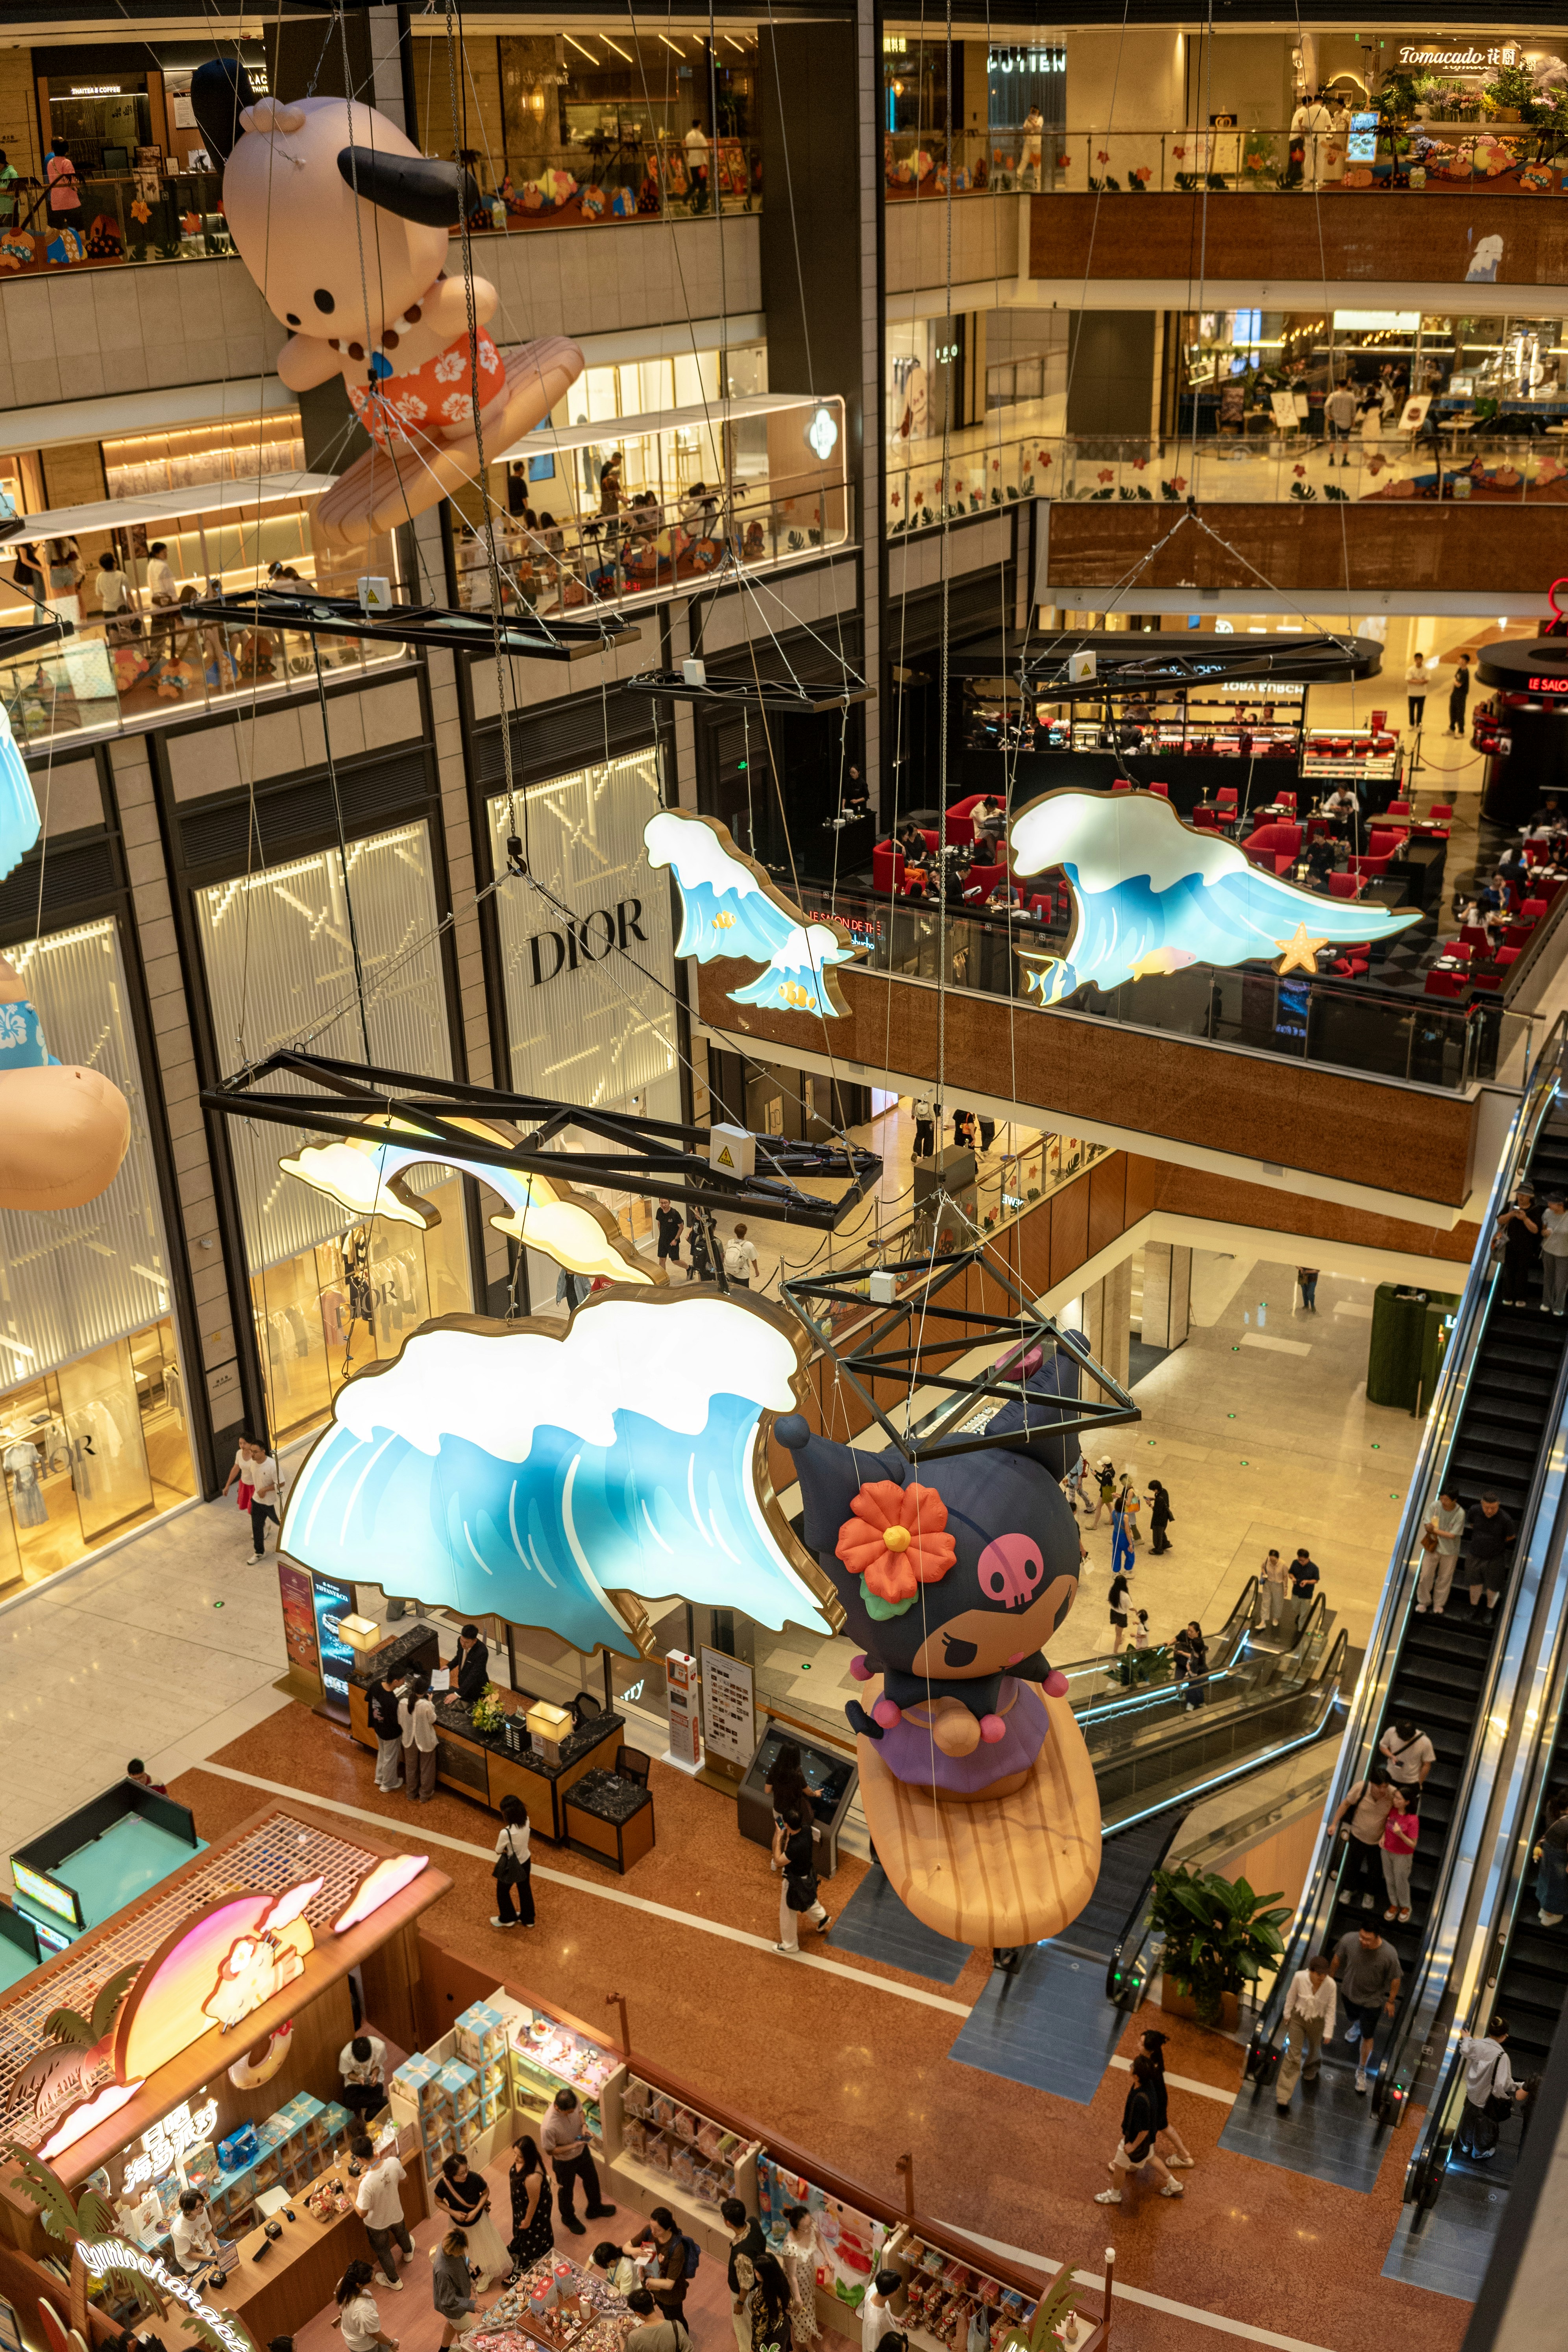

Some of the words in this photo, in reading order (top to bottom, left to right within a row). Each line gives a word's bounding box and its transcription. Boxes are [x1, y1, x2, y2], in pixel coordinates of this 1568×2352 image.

[1400, 47, 1485, 64] Tomacado
[1529, 678, 1540, 690] LE
[526, 899, 649, 987] DIOR
[852, 919, 863, 932] DE
[334, 1281, 399, 1329] DIOR
[14, 1435, 96, 1493] DIOR
[121, 2097, 218, 2194] 海岛派对
